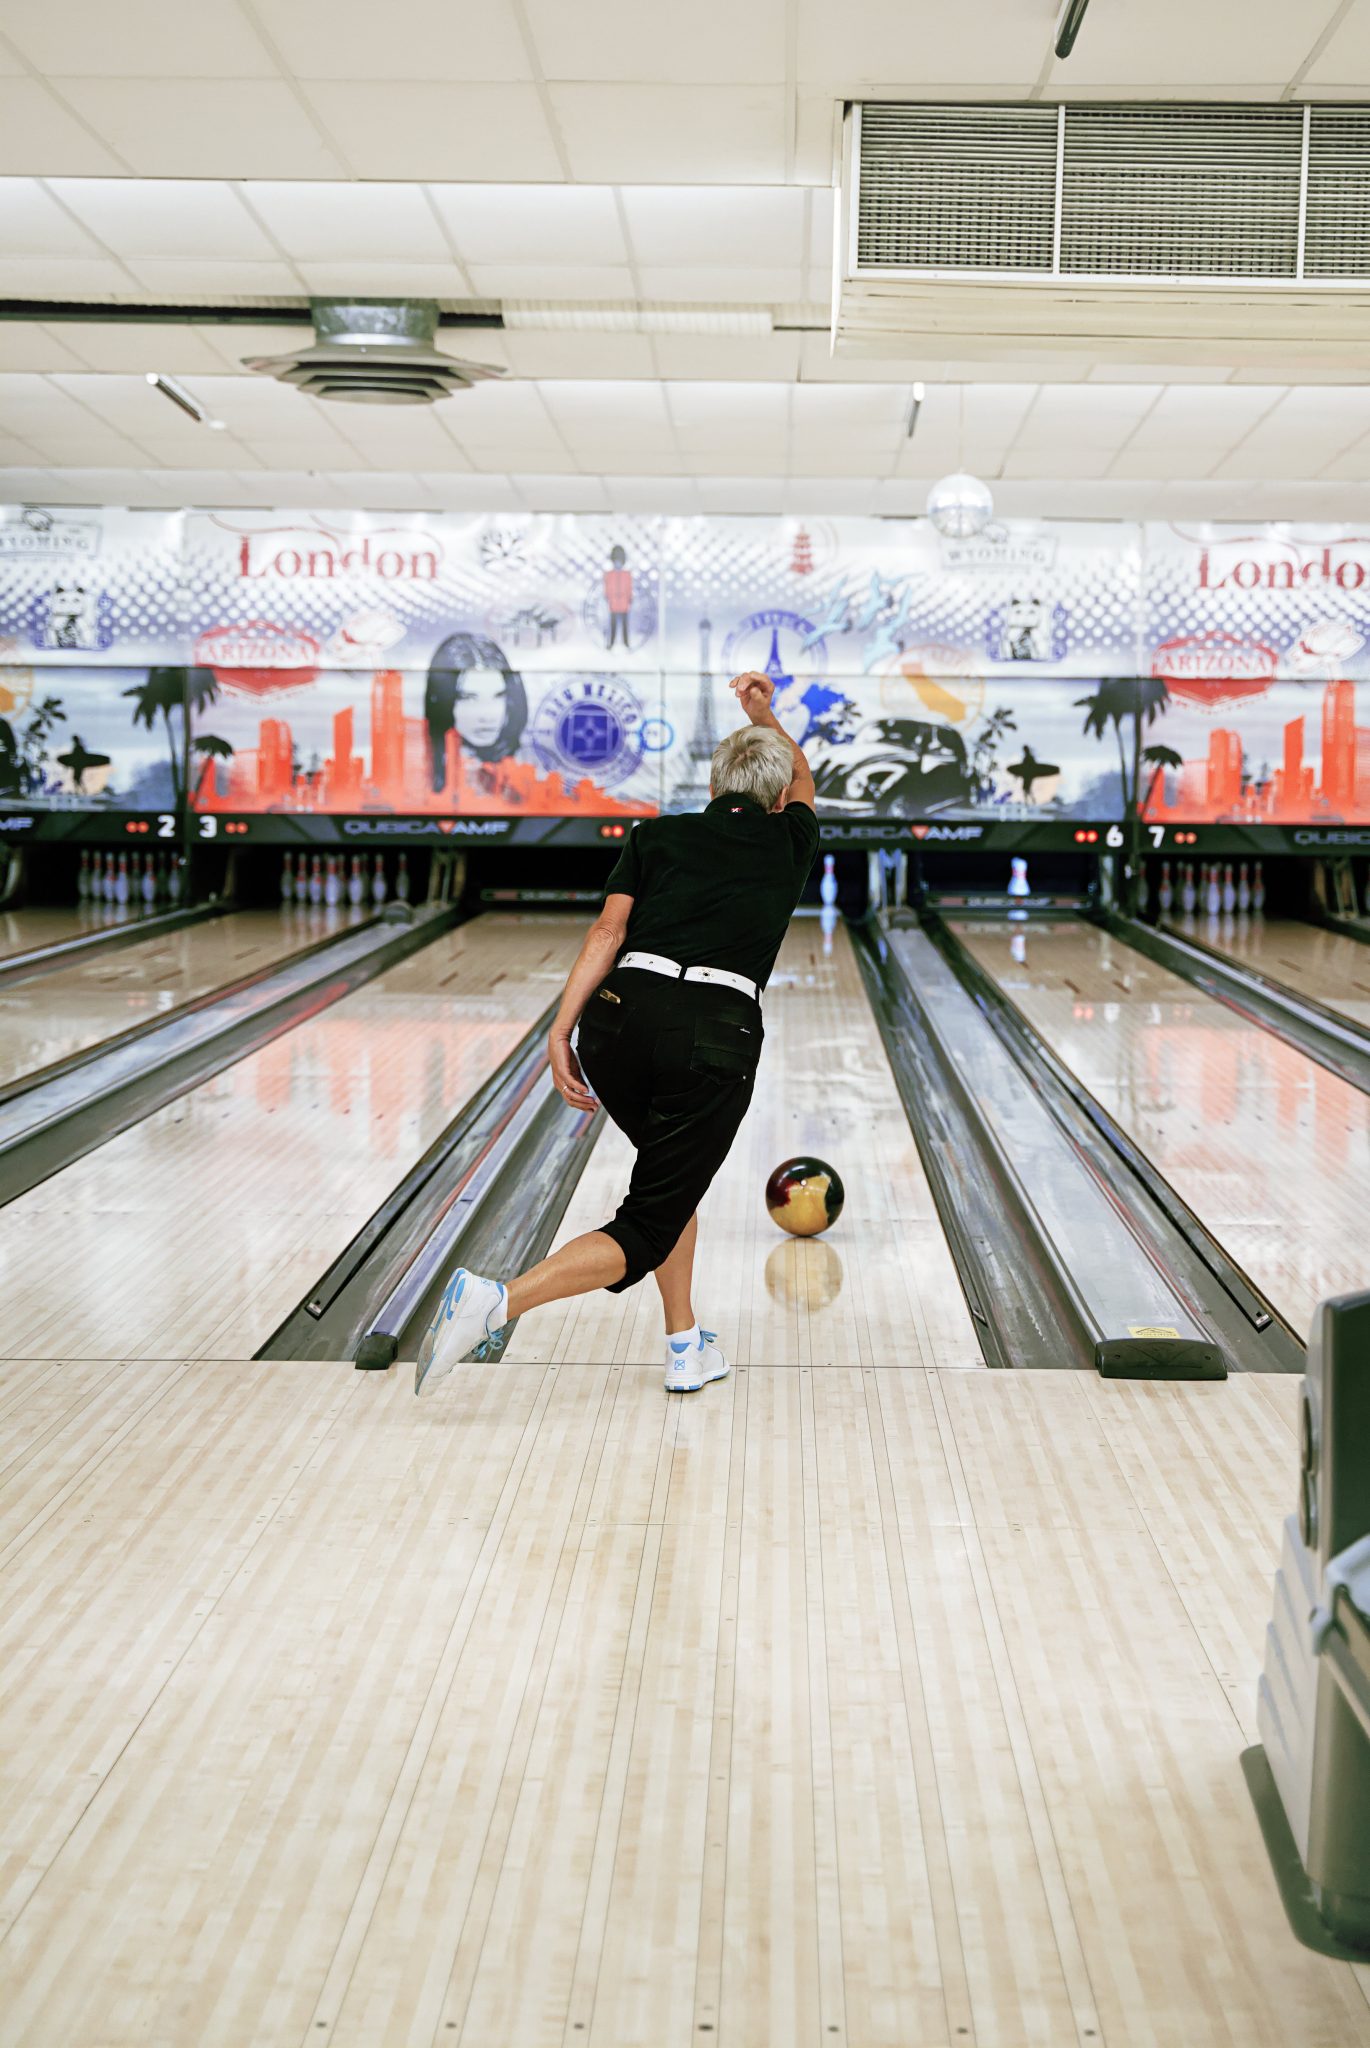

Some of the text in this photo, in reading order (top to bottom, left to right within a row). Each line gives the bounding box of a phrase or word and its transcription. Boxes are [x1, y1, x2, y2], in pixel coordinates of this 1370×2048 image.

[0, 536, 90, 550] YOMING
[239, 535, 438, 580] London
[1198, 548, 1370, 591] Londo
[207, 641, 312, 660] ARIZONA
[1162, 654, 1267, 672] ARIZONA
[157, 815, 175, 837] 2
[200, 815, 217, 838] 3
[1105, 825, 1123, 847] 6
[1149, 826, 1165, 848] 7
